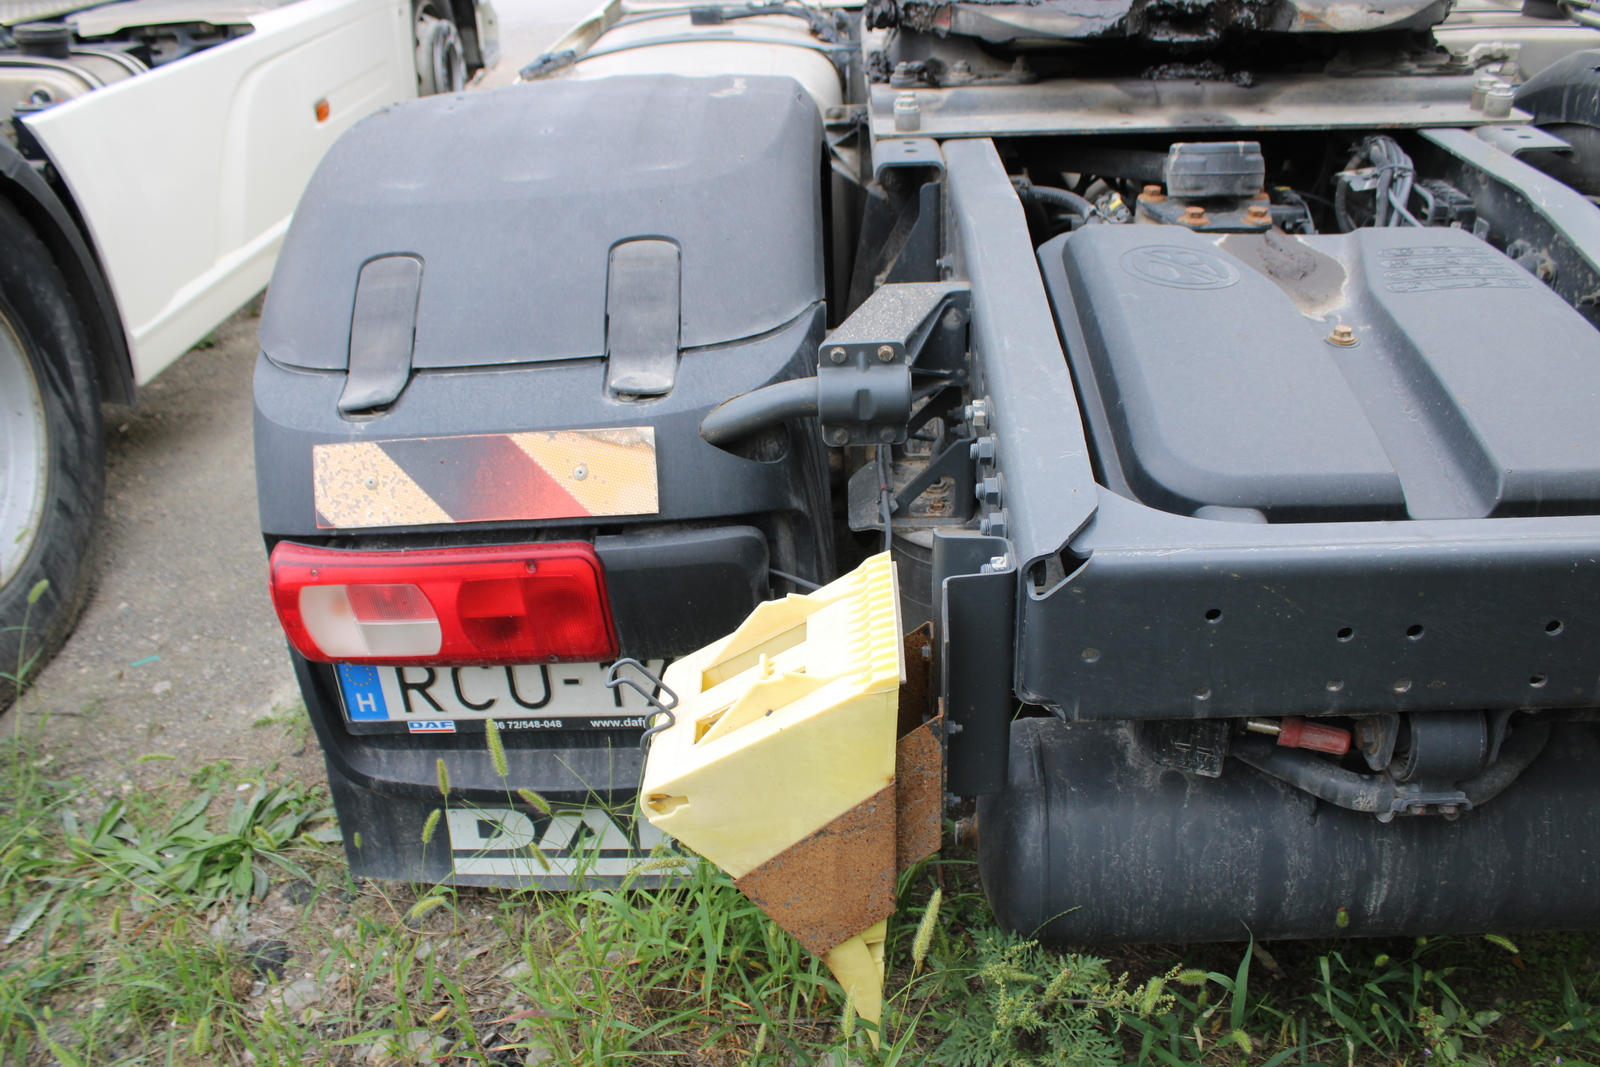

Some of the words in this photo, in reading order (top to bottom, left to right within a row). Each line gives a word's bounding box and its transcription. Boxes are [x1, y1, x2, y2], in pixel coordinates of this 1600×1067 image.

[355, 692, 377, 713] H
[408, 721, 454, 729] DAF
[506, 719, 562, 730] 72/548-048
[589, 717, 646, 728] www.daf
